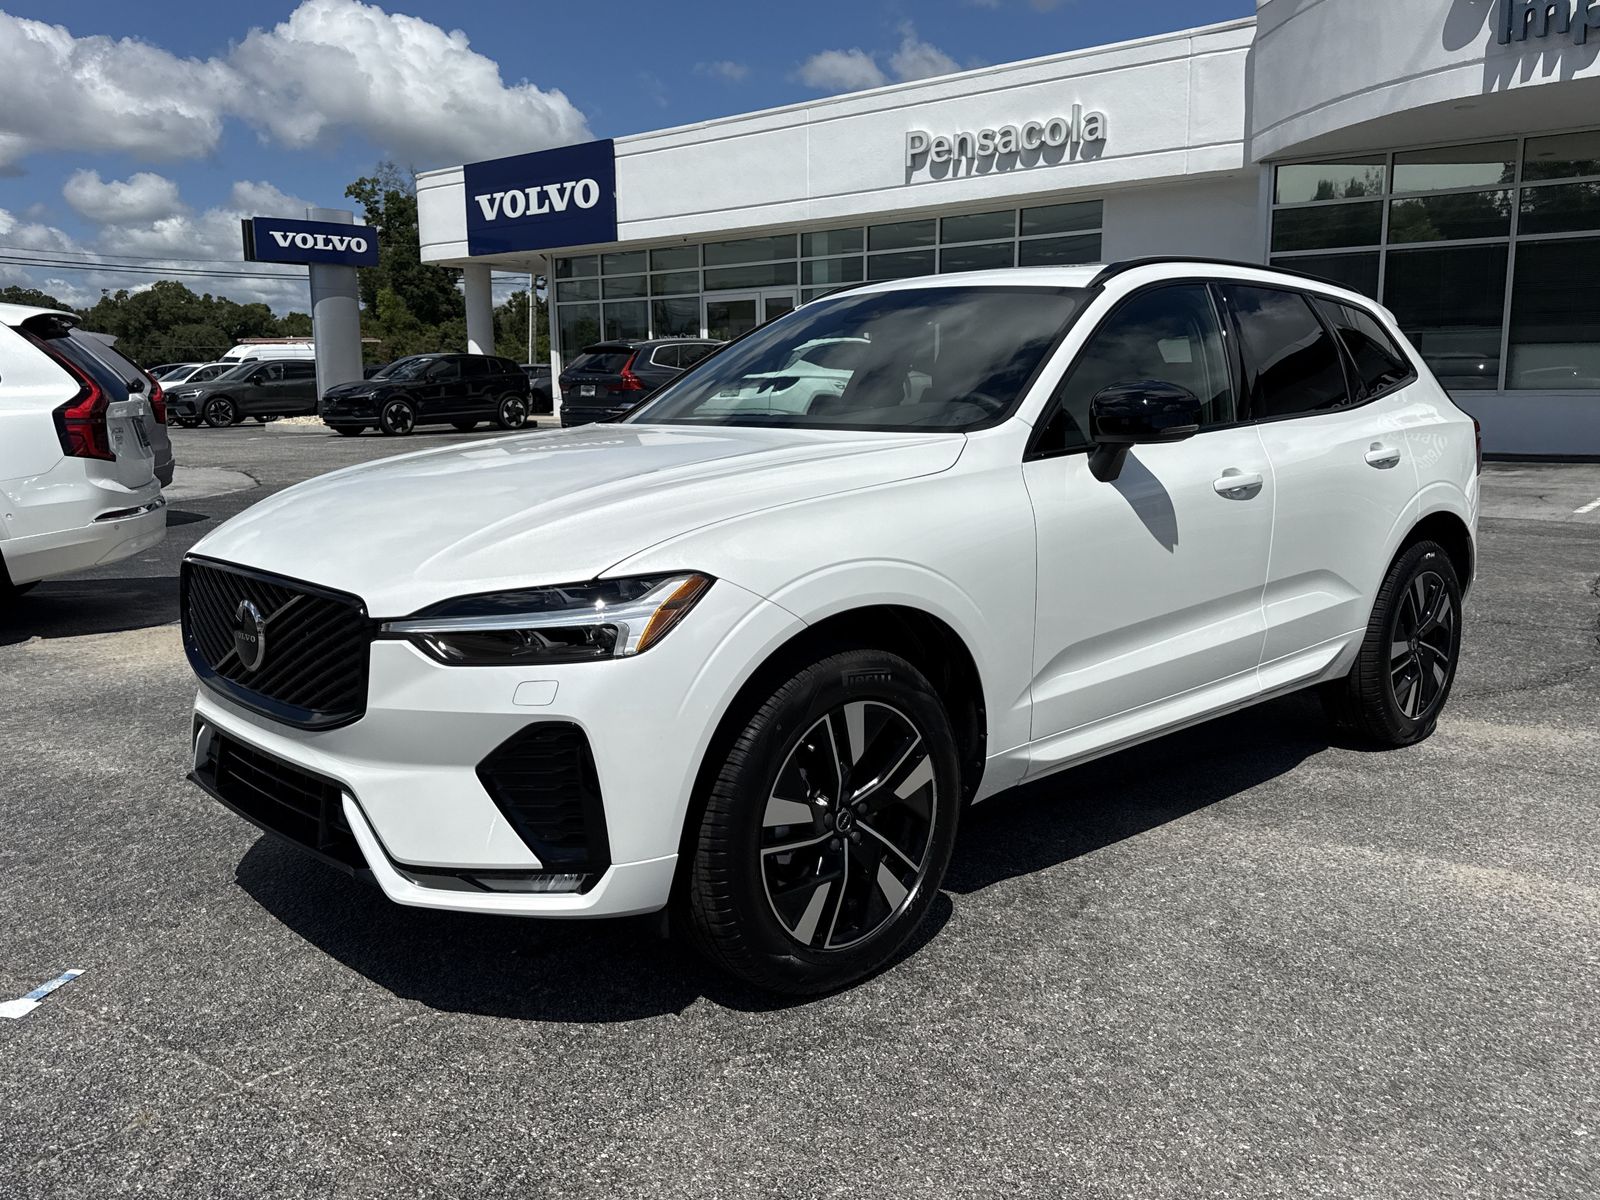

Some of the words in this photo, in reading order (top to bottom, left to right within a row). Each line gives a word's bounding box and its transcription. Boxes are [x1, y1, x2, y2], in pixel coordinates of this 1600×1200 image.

[905, 103, 1107, 167] Pensacola
[474, 178, 600, 221] VOLVO
[269, 231, 368, 253] VOLVO
